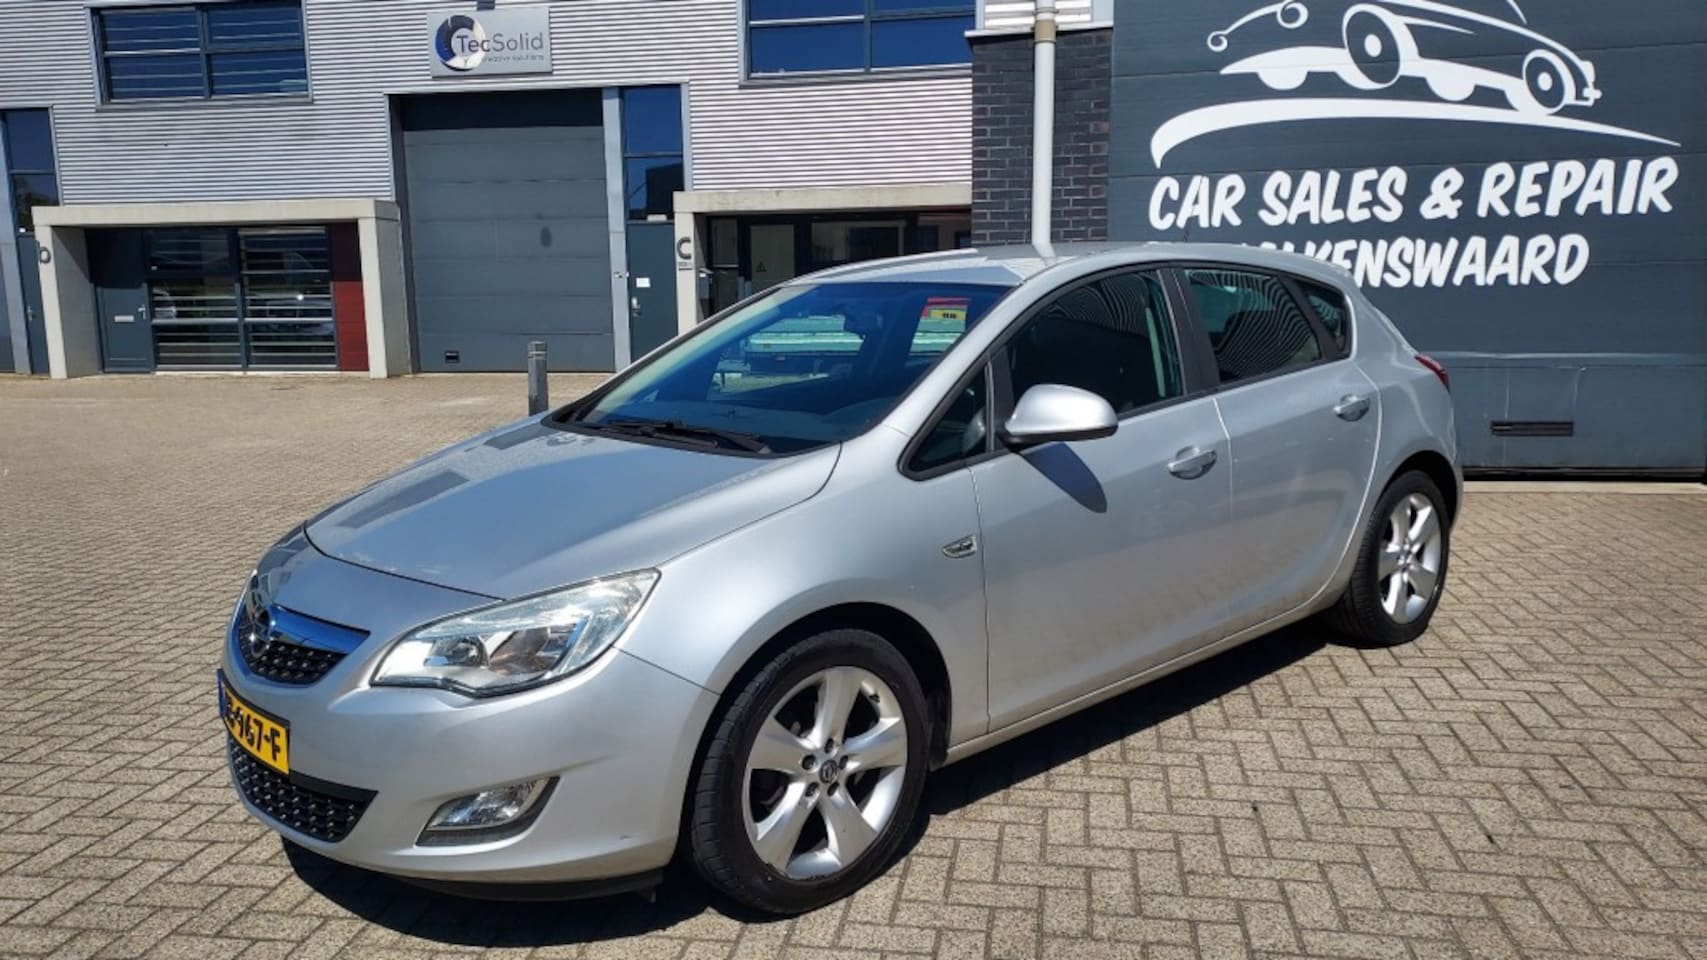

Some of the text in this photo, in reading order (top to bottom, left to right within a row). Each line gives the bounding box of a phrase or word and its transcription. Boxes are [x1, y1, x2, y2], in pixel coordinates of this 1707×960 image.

[456, 32, 544, 53] TecSolid
[1148, 155, 1680, 231] CAR SALES & REPAIR
[1241, 233, 1590, 288] ENSWAARD
